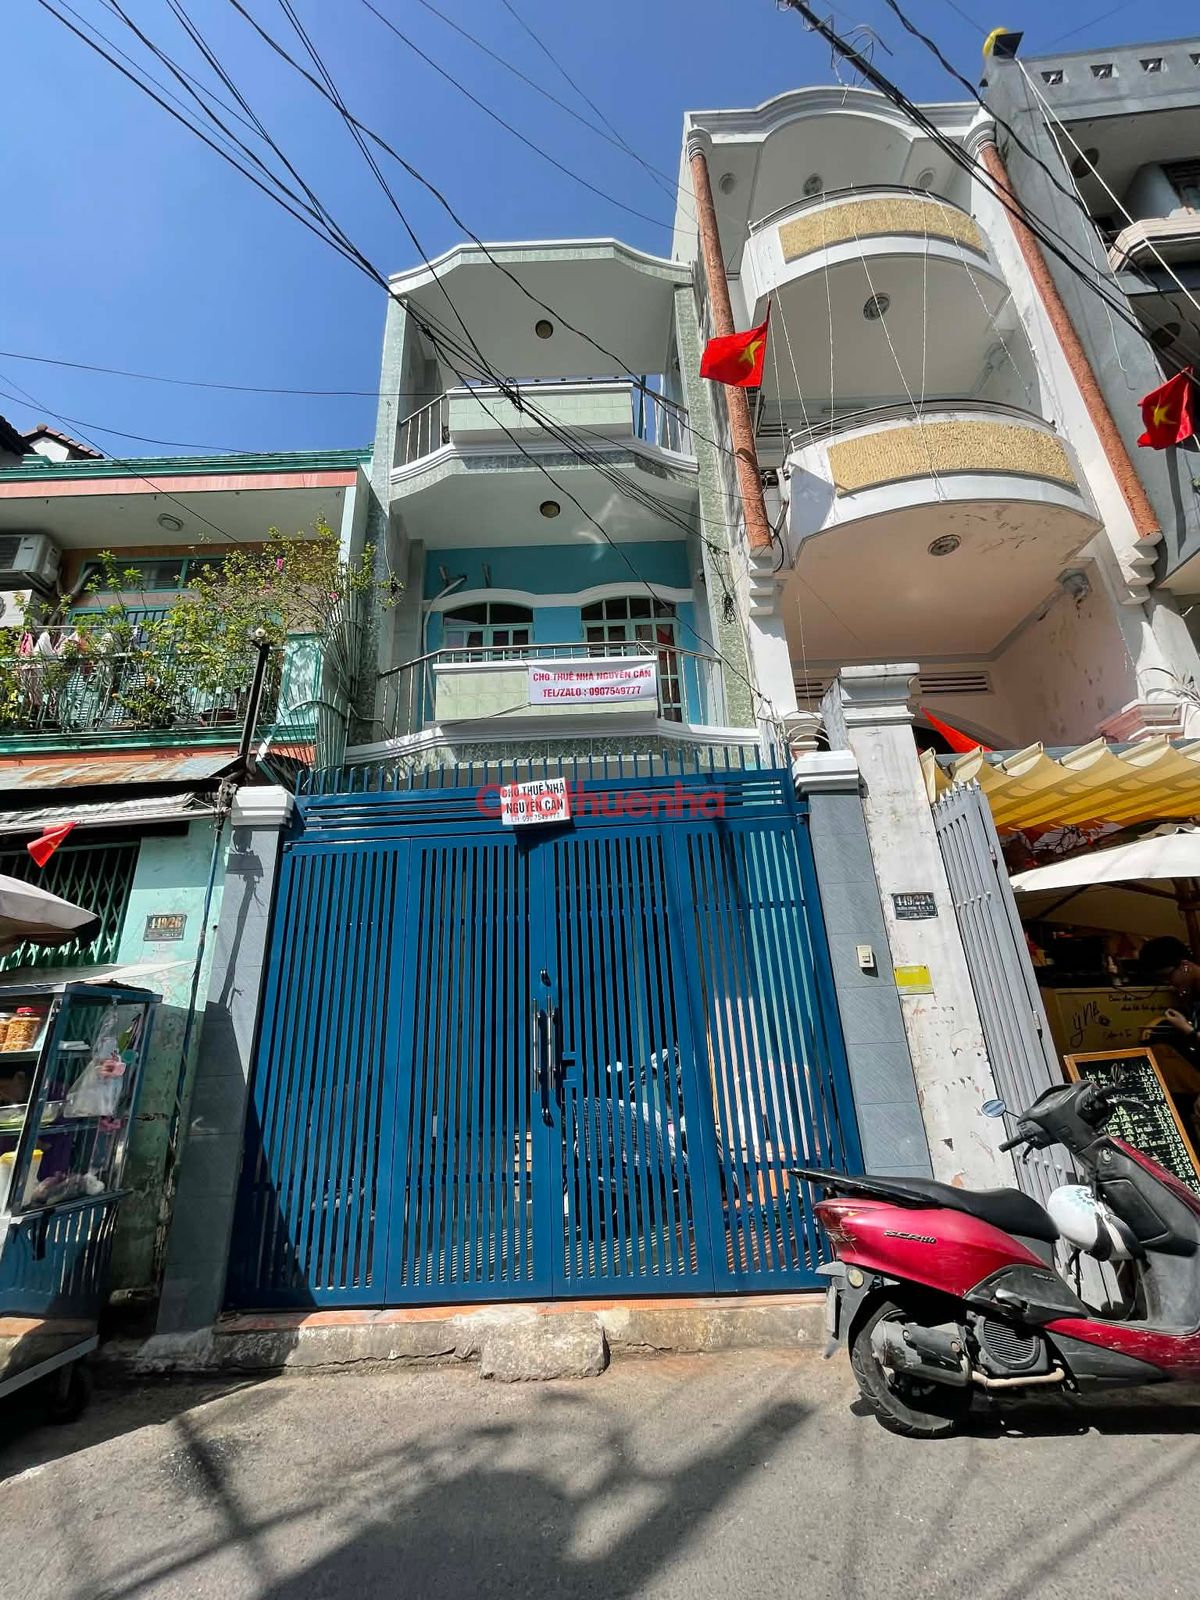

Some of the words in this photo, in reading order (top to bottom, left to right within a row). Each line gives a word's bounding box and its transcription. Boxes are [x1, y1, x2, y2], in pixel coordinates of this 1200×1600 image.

[533, 672, 550, 682] CHO
[553, 671, 575, 681] THUÊ
[543, 687, 582, 698] TEL/ZALO
[501, 786, 520, 798] CHO
[522, 783, 544, 796] THUÊ
